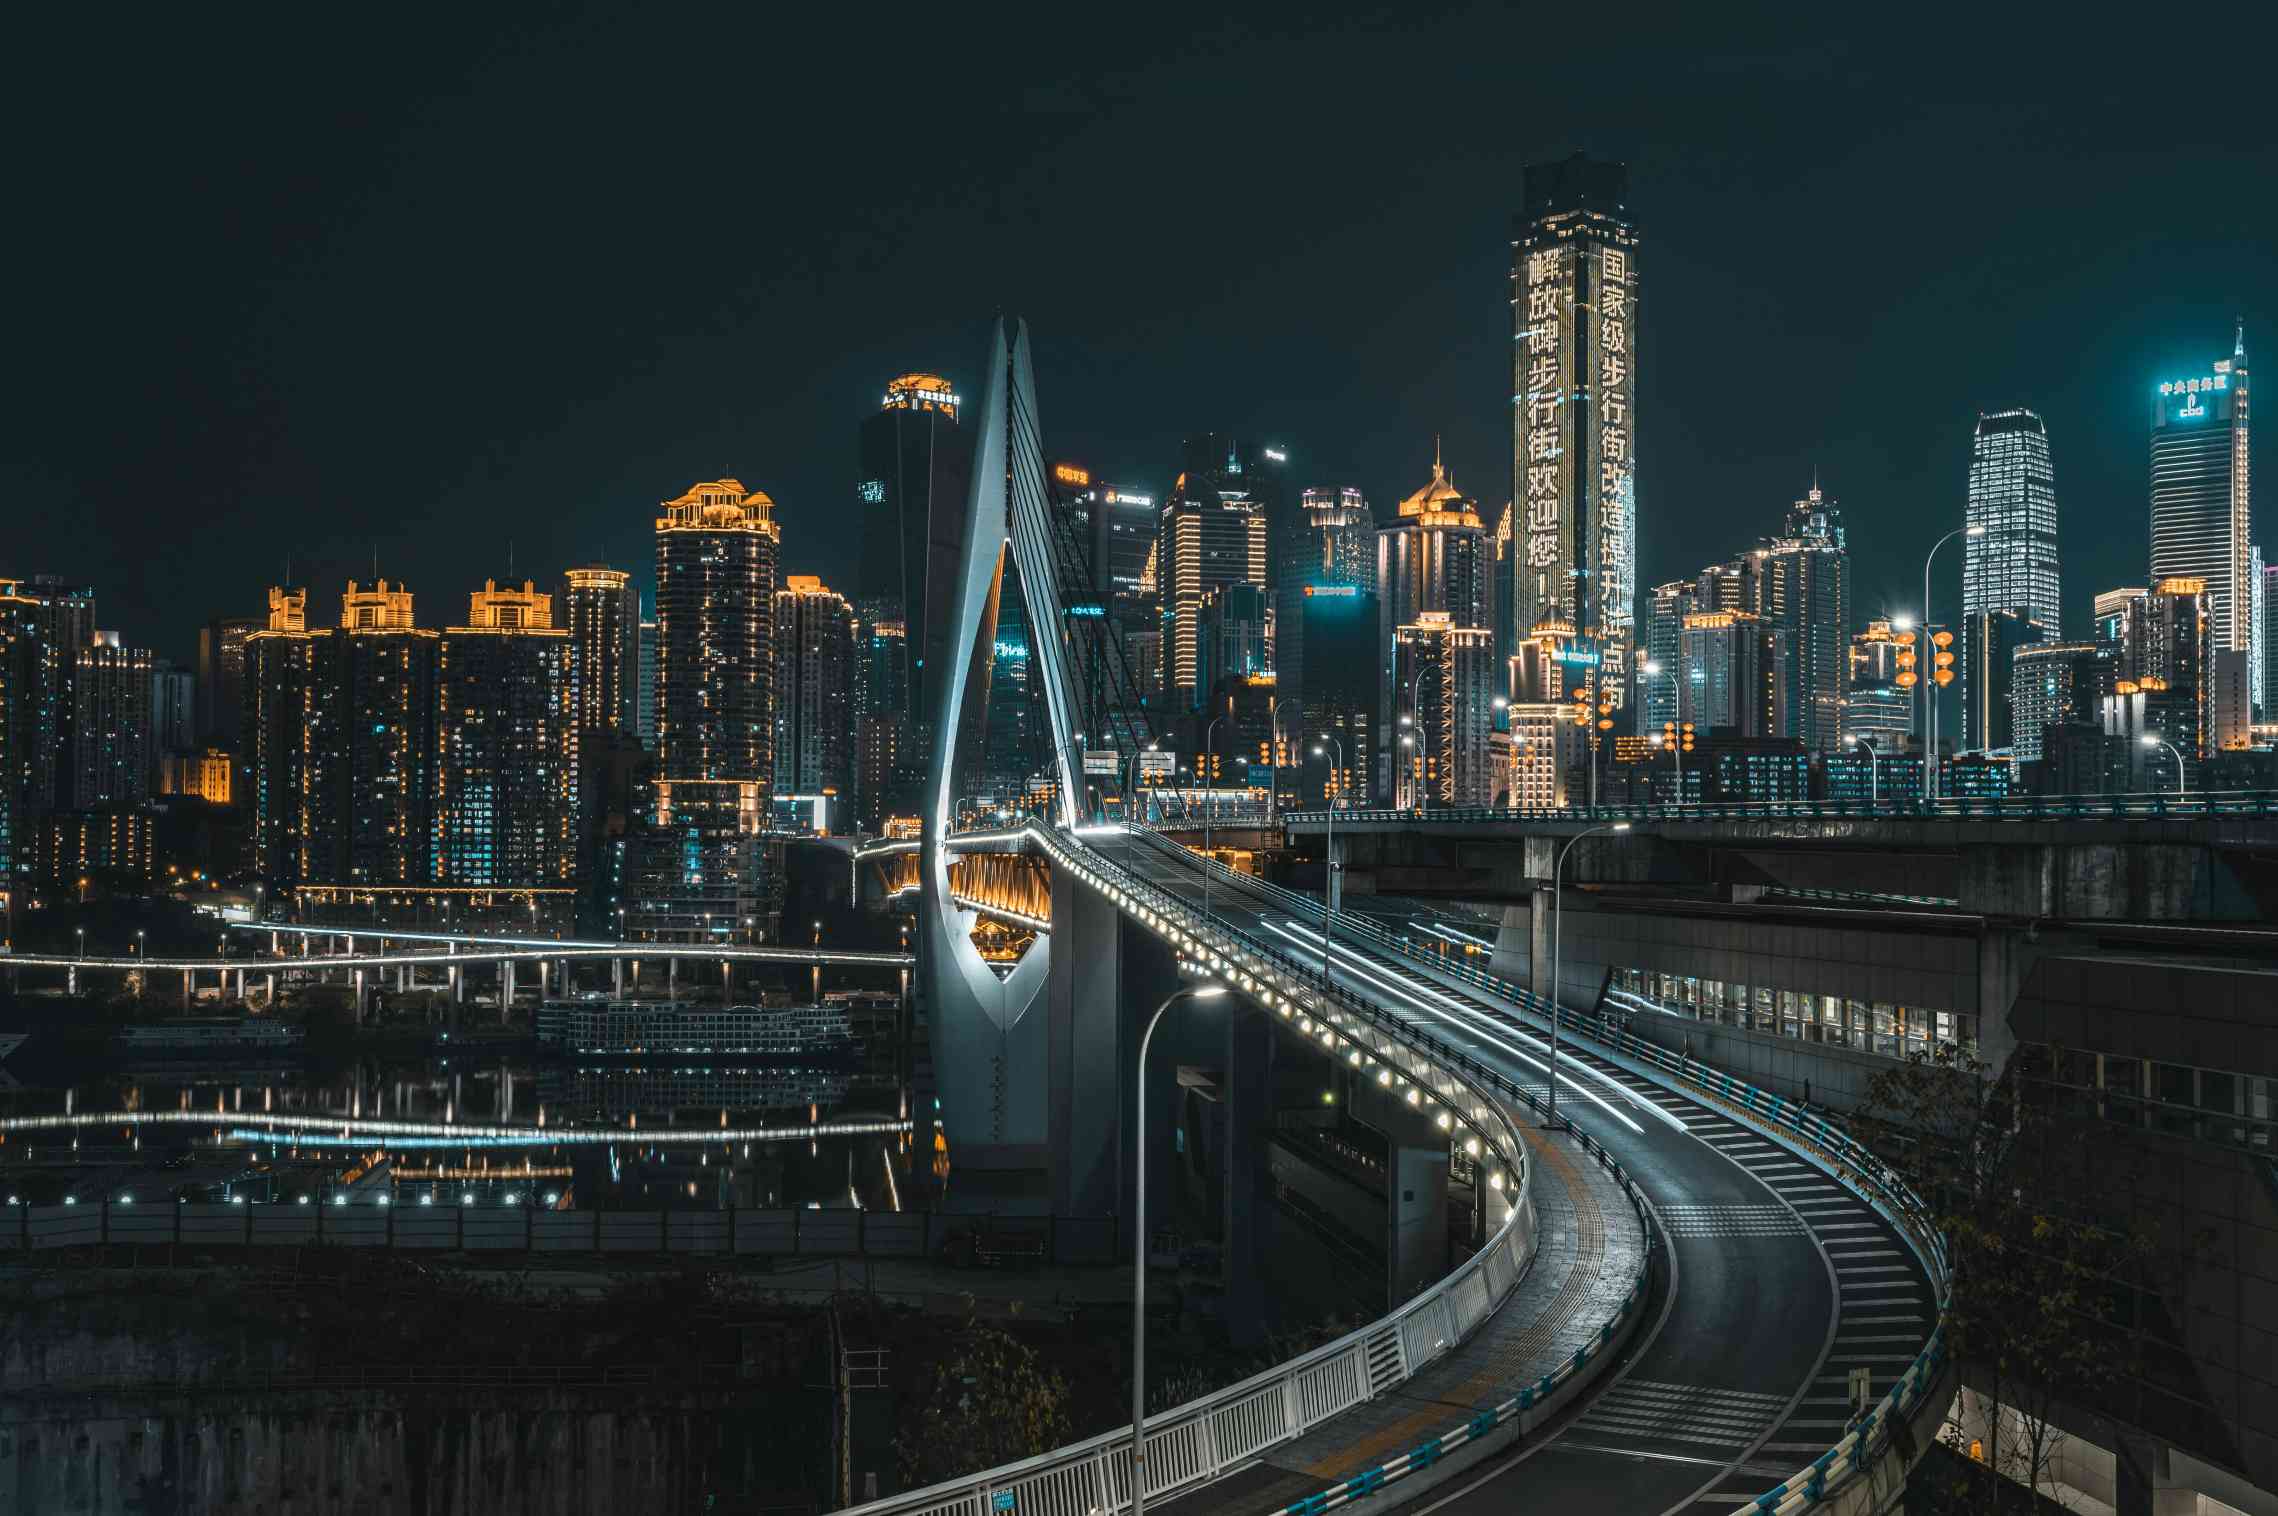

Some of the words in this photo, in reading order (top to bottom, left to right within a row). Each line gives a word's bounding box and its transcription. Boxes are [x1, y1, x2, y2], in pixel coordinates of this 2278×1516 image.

[2159, 376, 2227, 396] 中央商务区
